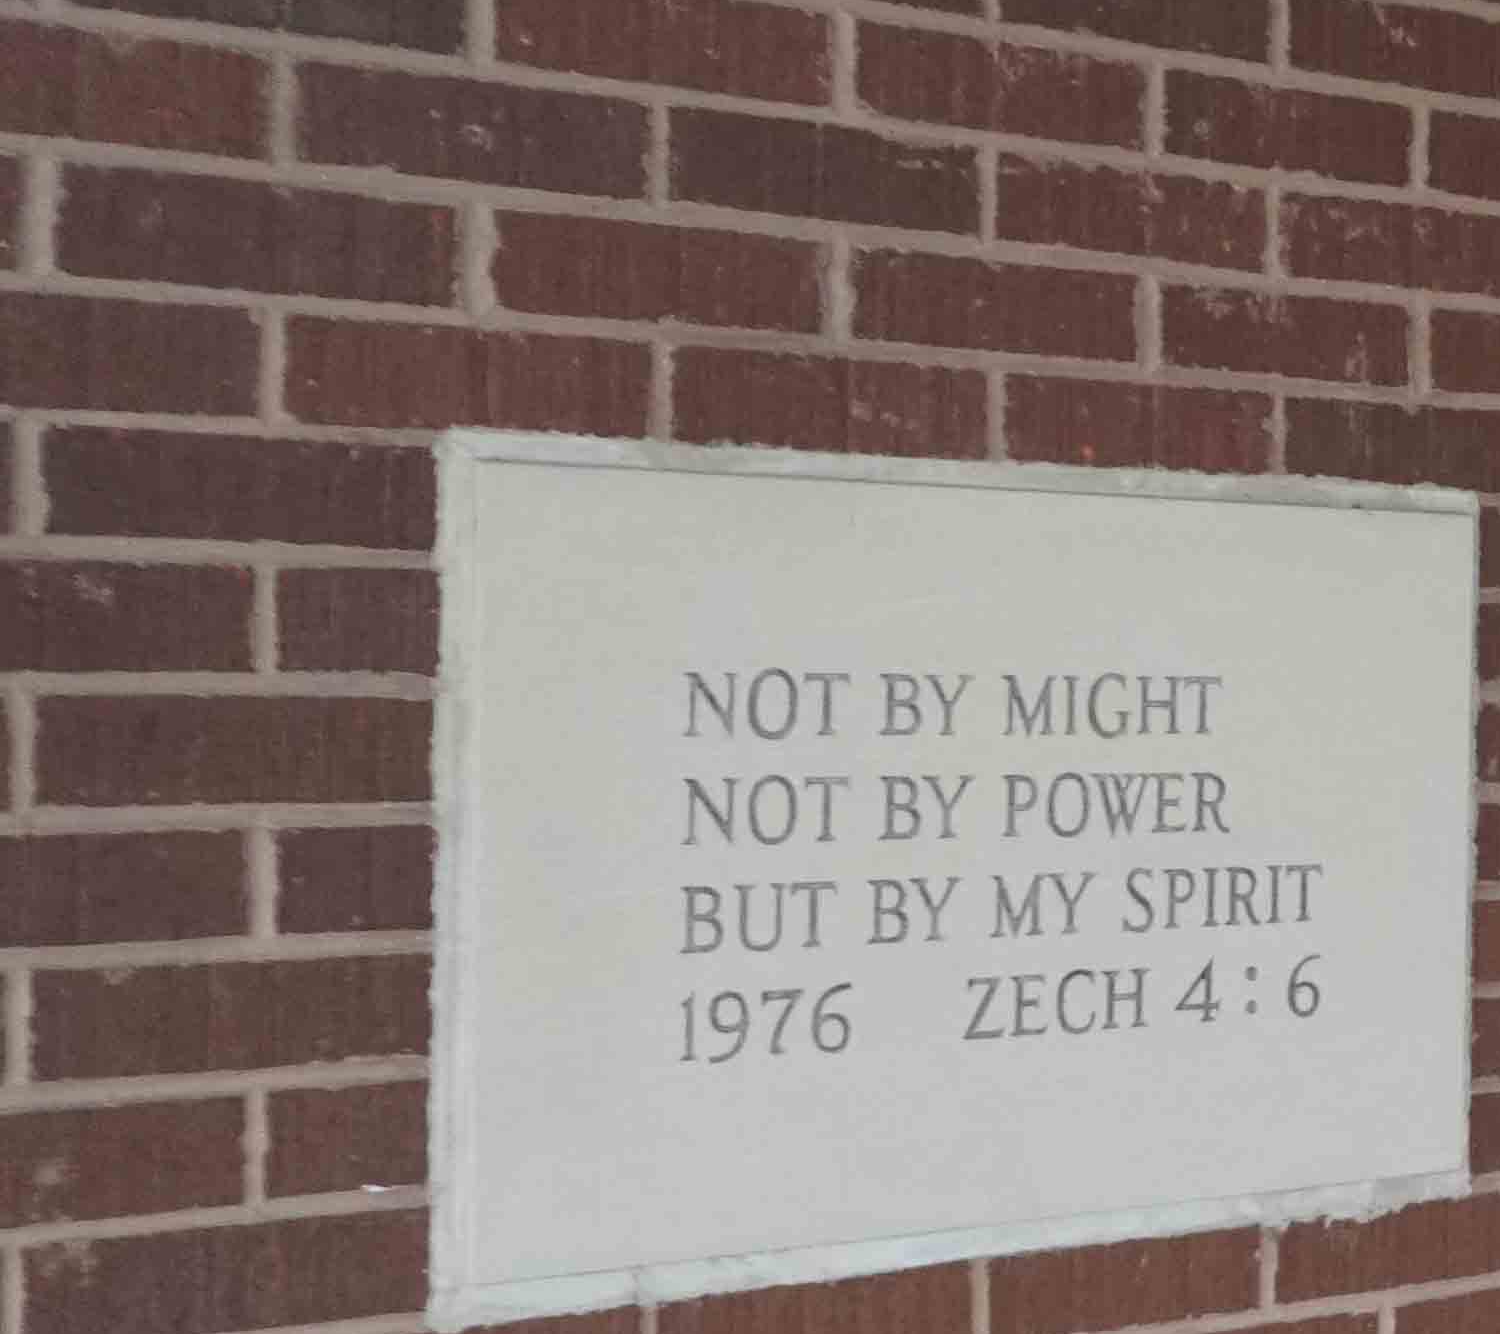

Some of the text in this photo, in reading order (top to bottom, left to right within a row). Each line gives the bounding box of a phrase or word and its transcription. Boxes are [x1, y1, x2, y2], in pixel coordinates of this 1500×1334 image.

[681, 667, 1224, 741] NOT BY MIGHT
[680, 771, 1231, 846] NOT BY POWER
[679, 863, 1323, 954] BUT BY MY SPIRIT
[680, 981, 853, 1064] 1976
[962, 967, 1149, 1040] ZECH
